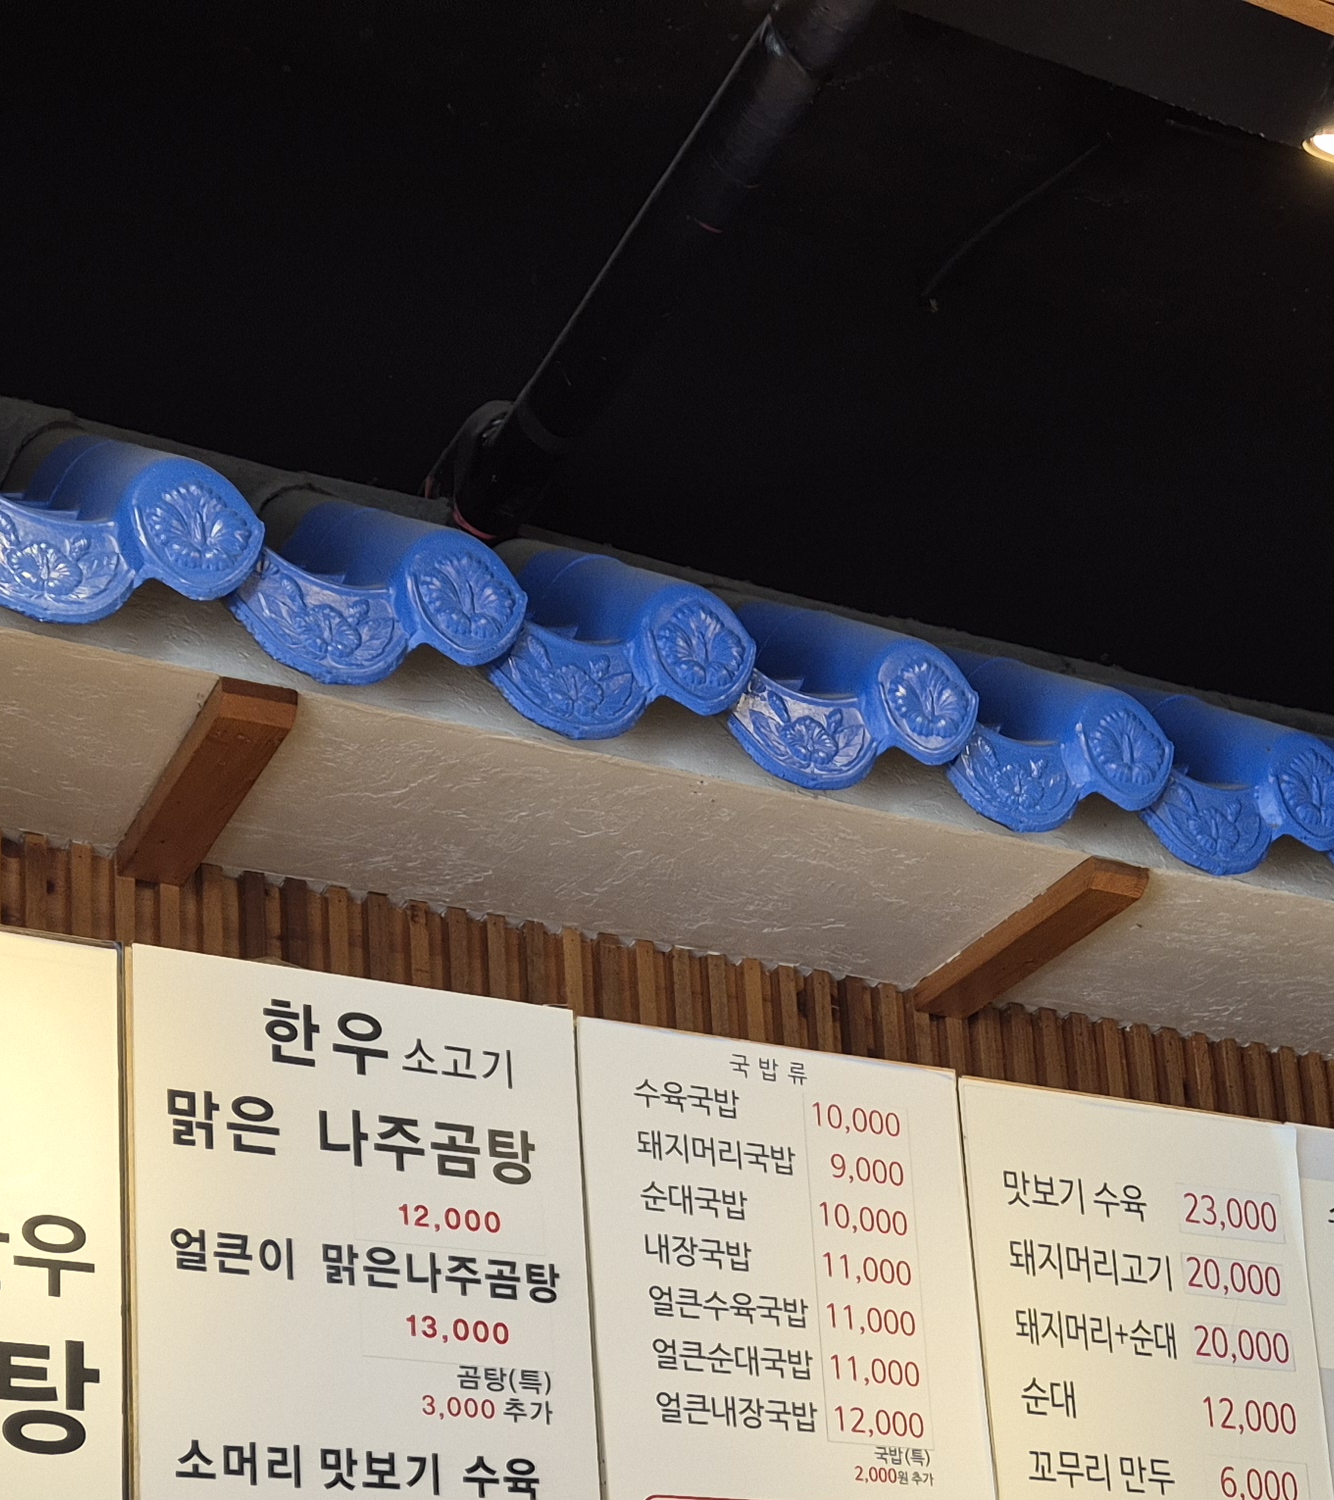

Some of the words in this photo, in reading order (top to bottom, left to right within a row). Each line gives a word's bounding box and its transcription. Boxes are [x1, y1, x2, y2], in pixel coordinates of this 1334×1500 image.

[263, 999, 388, 1076] 한우
[401, 1038, 514, 1089] 소고기
[634, 1079, 739, 1120] 수육국밥
[811, 1101, 901, 1137] 10,000
[167, 1089, 279, 1157] 맑은
[318, 1109, 536, 1186] 나주곰탕
[637, 1131, 795, 1177] 돼지머리국밥
[830, 1153, 904, 1187] 9,000
[398, 1203, 502, 1235] 12,000
[640, 1180, 748, 1221] 순대국밥
[819, 1201, 908, 1236] 10,000
[1002, 1170, 1085, 1216] 맛보기
[1093, 1182, 1147, 1222] 수육
[1183, 1191, 1277, 1233] 23,000
[170, 1227, 295, 1281] 얼큰이
[322, 1242, 559, 1304] 맑은나주곰탕
[644, 1233, 751, 1273] 내장국밥
[823, 1251, 912, 1287] 11,000
[1009, 1238, 1172, 1292] 돼지머리고기
[1187, 1256, 1281, 1298] 20,000
[406, 1314, 510, 1346] 13,000
[648, 1285, 808, 1329] 얼큰수육국밥
[826, 1302, 916, 1337] 11,000
[1016, 1308, 1177, 1360] 돼지머리+순대
[1194, 1325, 1289, 1365] 20,000
[457, 1364, 552, 1396] 곰탕(특)
[652, 1338, 812, 1381] 얼큰순대국밥
[830, 1353, 920, 1389] 11,000
[421, 1395, 496, 1421] 3,000
[503, 1399, 554, 1426] 추가
[656, 1391, 817, 1433] 얼큰내장국밥
[834, 1405, 924, 1439] 12,000
[1021, 1377, 1076, 1419] 순대
[1203, 1395, 1297, 1435] 12,000
[176, 1439, 302, 1489] 소머리
[319, 1447, 441, 1496] 맛보기
[463, 1455, 539, 1500] 수육
[874, 1446, 930, 1467] 국밥(특)
[912, 1471, 934, 1486] 추가
[1029, 1451, 1111, 1491] 꼬무리
[1119, 1456, 1175, 1495] 만두
